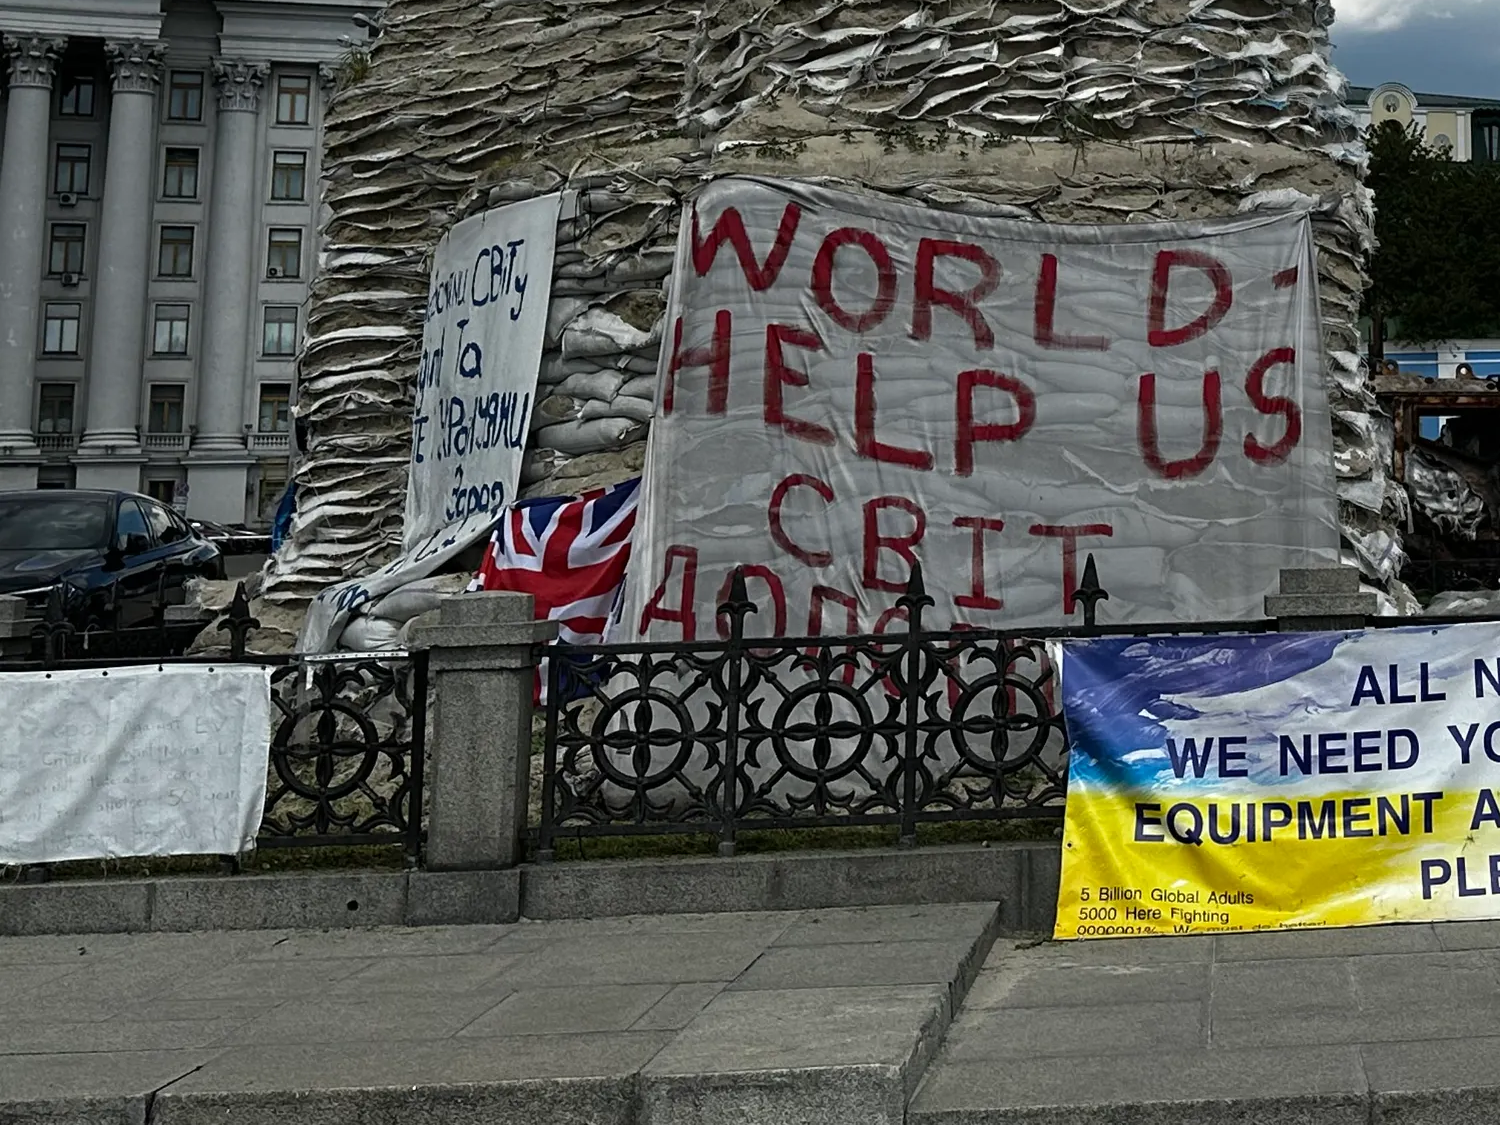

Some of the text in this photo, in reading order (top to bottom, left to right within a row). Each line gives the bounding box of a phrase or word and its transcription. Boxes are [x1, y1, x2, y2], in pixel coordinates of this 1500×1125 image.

[663, 308, 1301, 480] HELP US
[1350, 662, 1446, 707] ALL
[1167, 735, 1248, 779] WE
[1279, 728, 1420, 776] NEED
[1134, 791, 1443, 846] EQUIPMENT
[1078, 906, 1230, 925] 5000 Here Fighting
[1080, 887, 1254, 905] 5 Billion Global Adults
